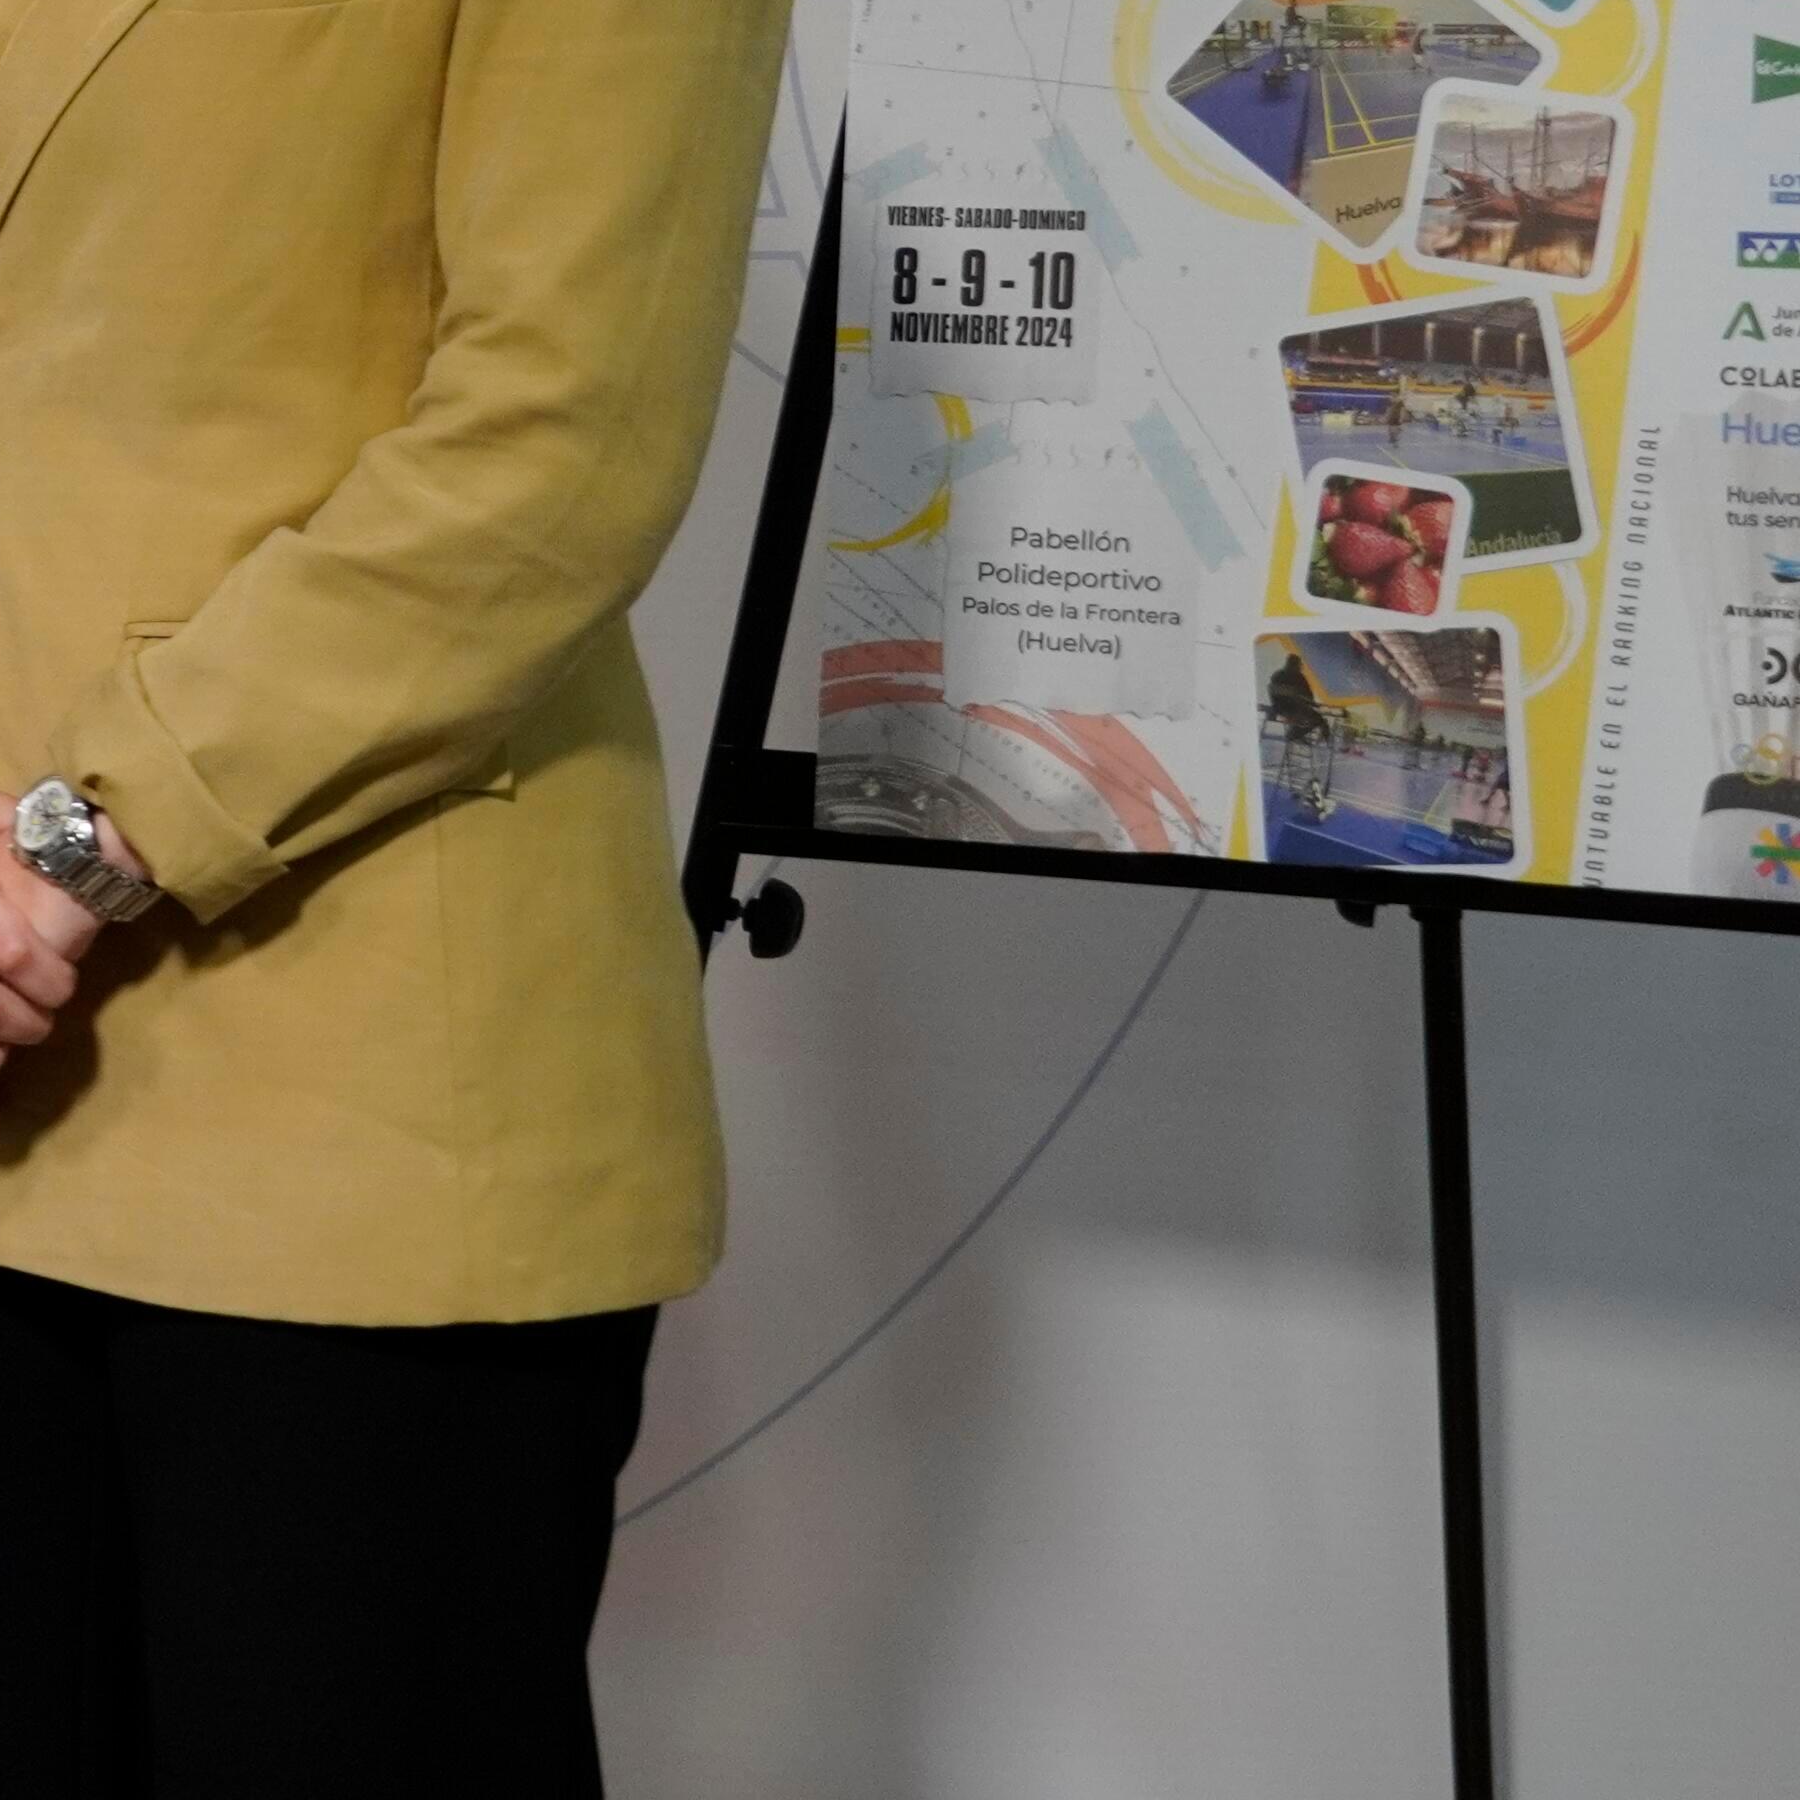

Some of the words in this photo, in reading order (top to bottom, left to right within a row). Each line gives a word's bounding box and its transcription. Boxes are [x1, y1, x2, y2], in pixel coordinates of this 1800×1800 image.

[1336, 196, 1402, 223] Huelva
[893, 247, 918, 305] 8
[960, 249, 986, 307] 9
[1029, 251, 1075, 310] 10
[890, 311, 1009, 346] NOVIEMBRE
[1015, 316, 1072, 348] 2024
[1626, 426, 1662, 545] NACIONAL
[1726, 510, 1759, 528] tus
[1010, 525, 1130, 554] Pabellón
[977, 561, 1162, 593] Polideportivo
[962, 596, 1020, 618] Palos
[1028, 600, 1055, 620] de
[1059, 602, 1079, 621] la
[1085, 603, 1182, 627] Frontera
[1609, 560, 1644, 667] RANKING
[1017, 629, 1123, 660] (Huelva)
[1606, 684, 1629, 707] EL
[1600, 722, 1623, 750] EN
